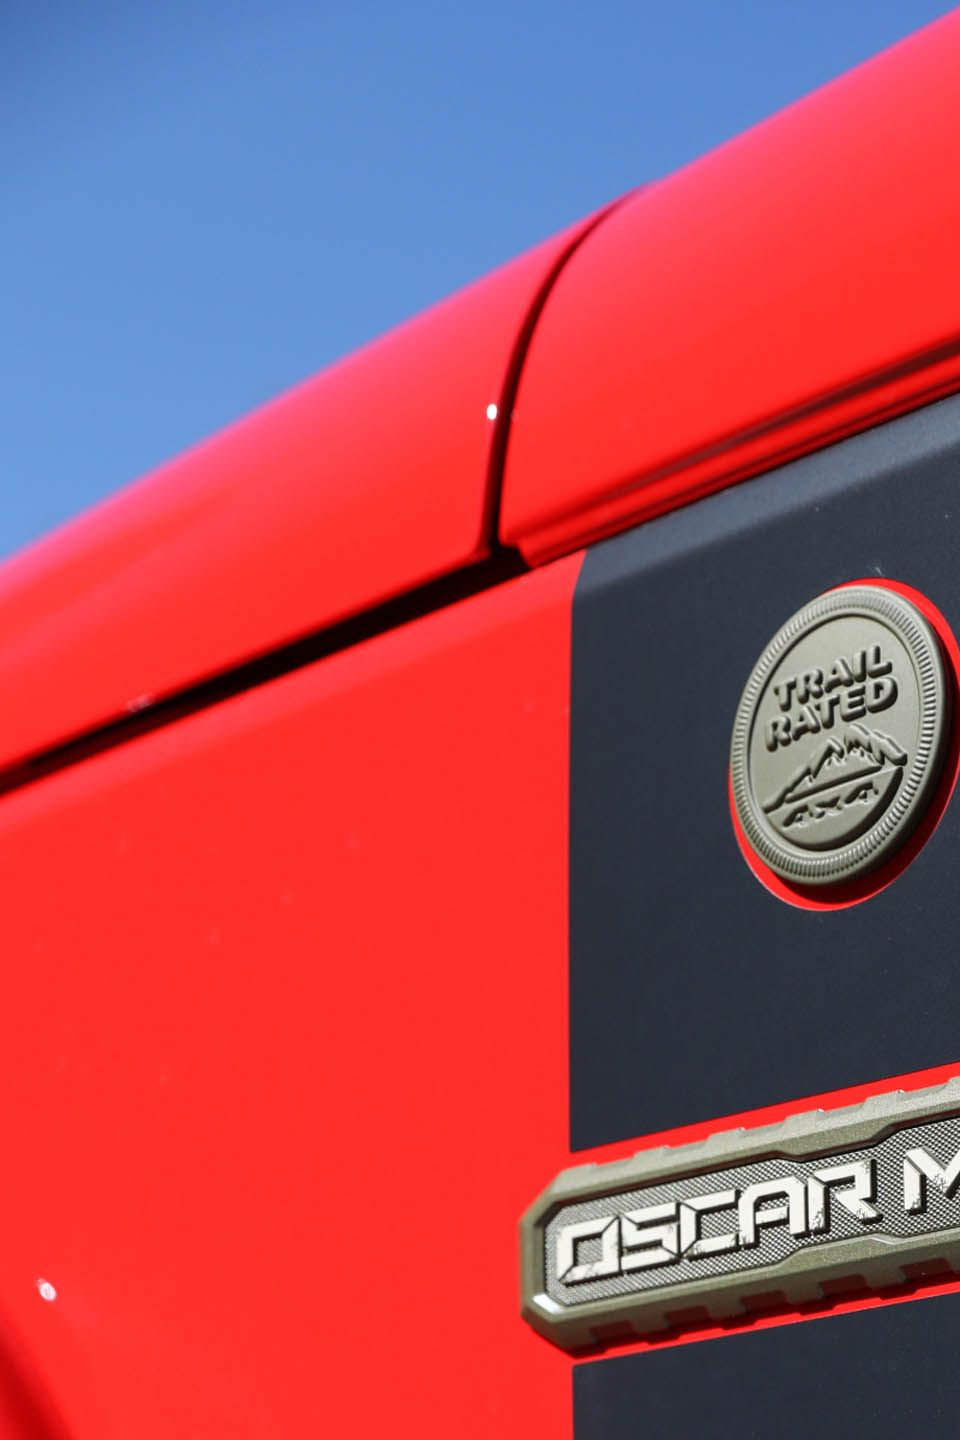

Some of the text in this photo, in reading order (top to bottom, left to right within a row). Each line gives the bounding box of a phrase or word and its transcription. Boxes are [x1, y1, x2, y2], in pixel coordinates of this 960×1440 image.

[765, 676, 899, 753] RATED
[772, 645, 893, 712] TRAIL
[556, 1158, 882, 1287] OSCAR
